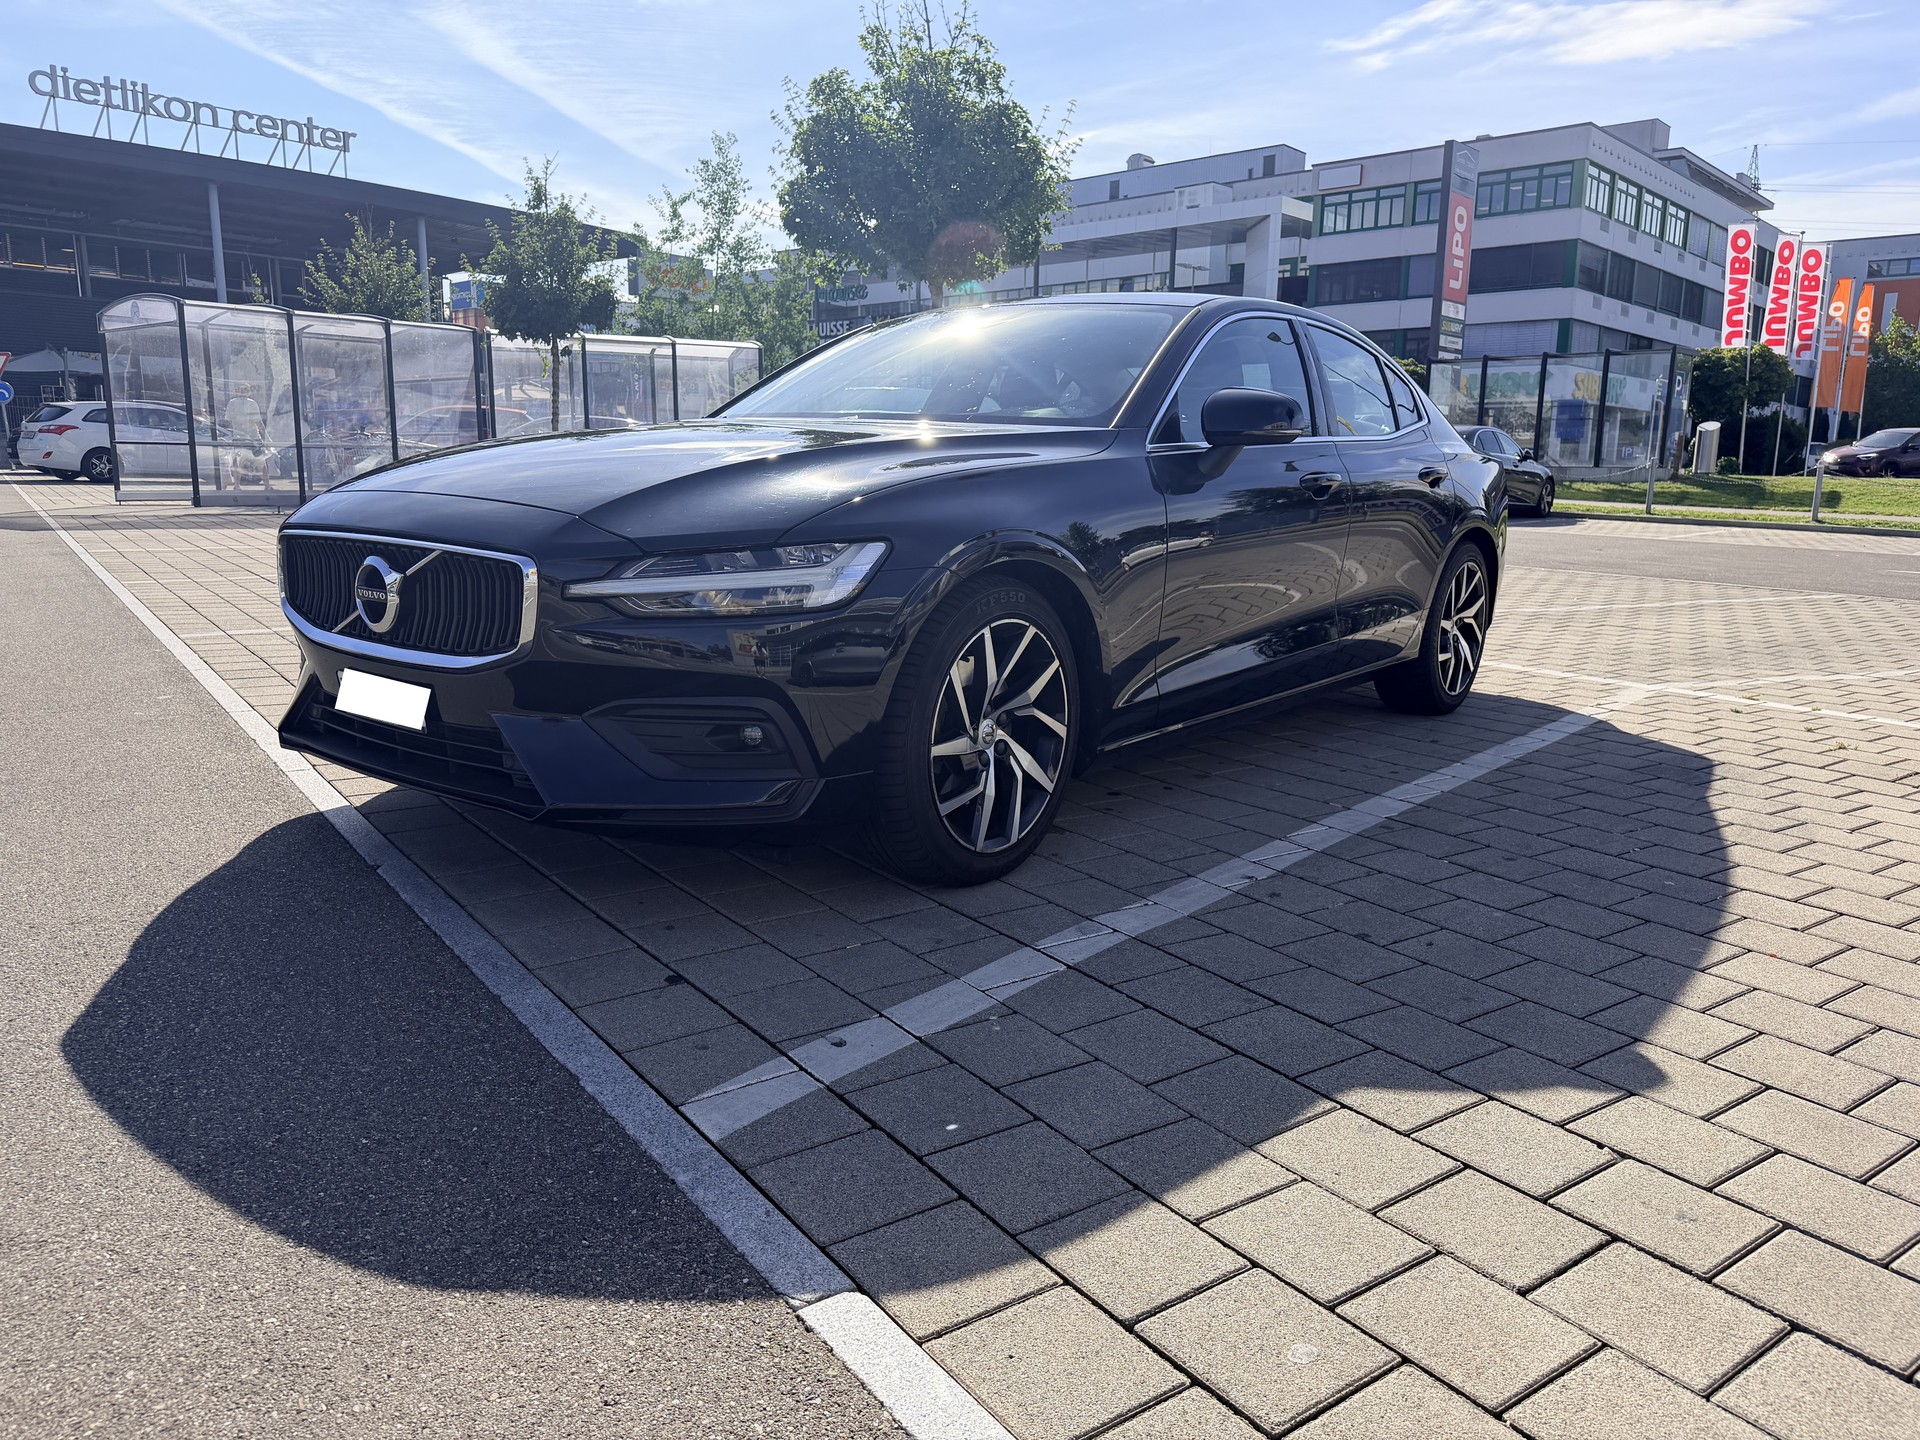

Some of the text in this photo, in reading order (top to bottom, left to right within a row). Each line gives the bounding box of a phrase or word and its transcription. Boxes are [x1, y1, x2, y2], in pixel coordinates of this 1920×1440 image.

[28, 64, 357, 152] dietlikon center
[1573, 372, 1627, 403] SUBAY
[358, 589, 385, 600] VOLVO
